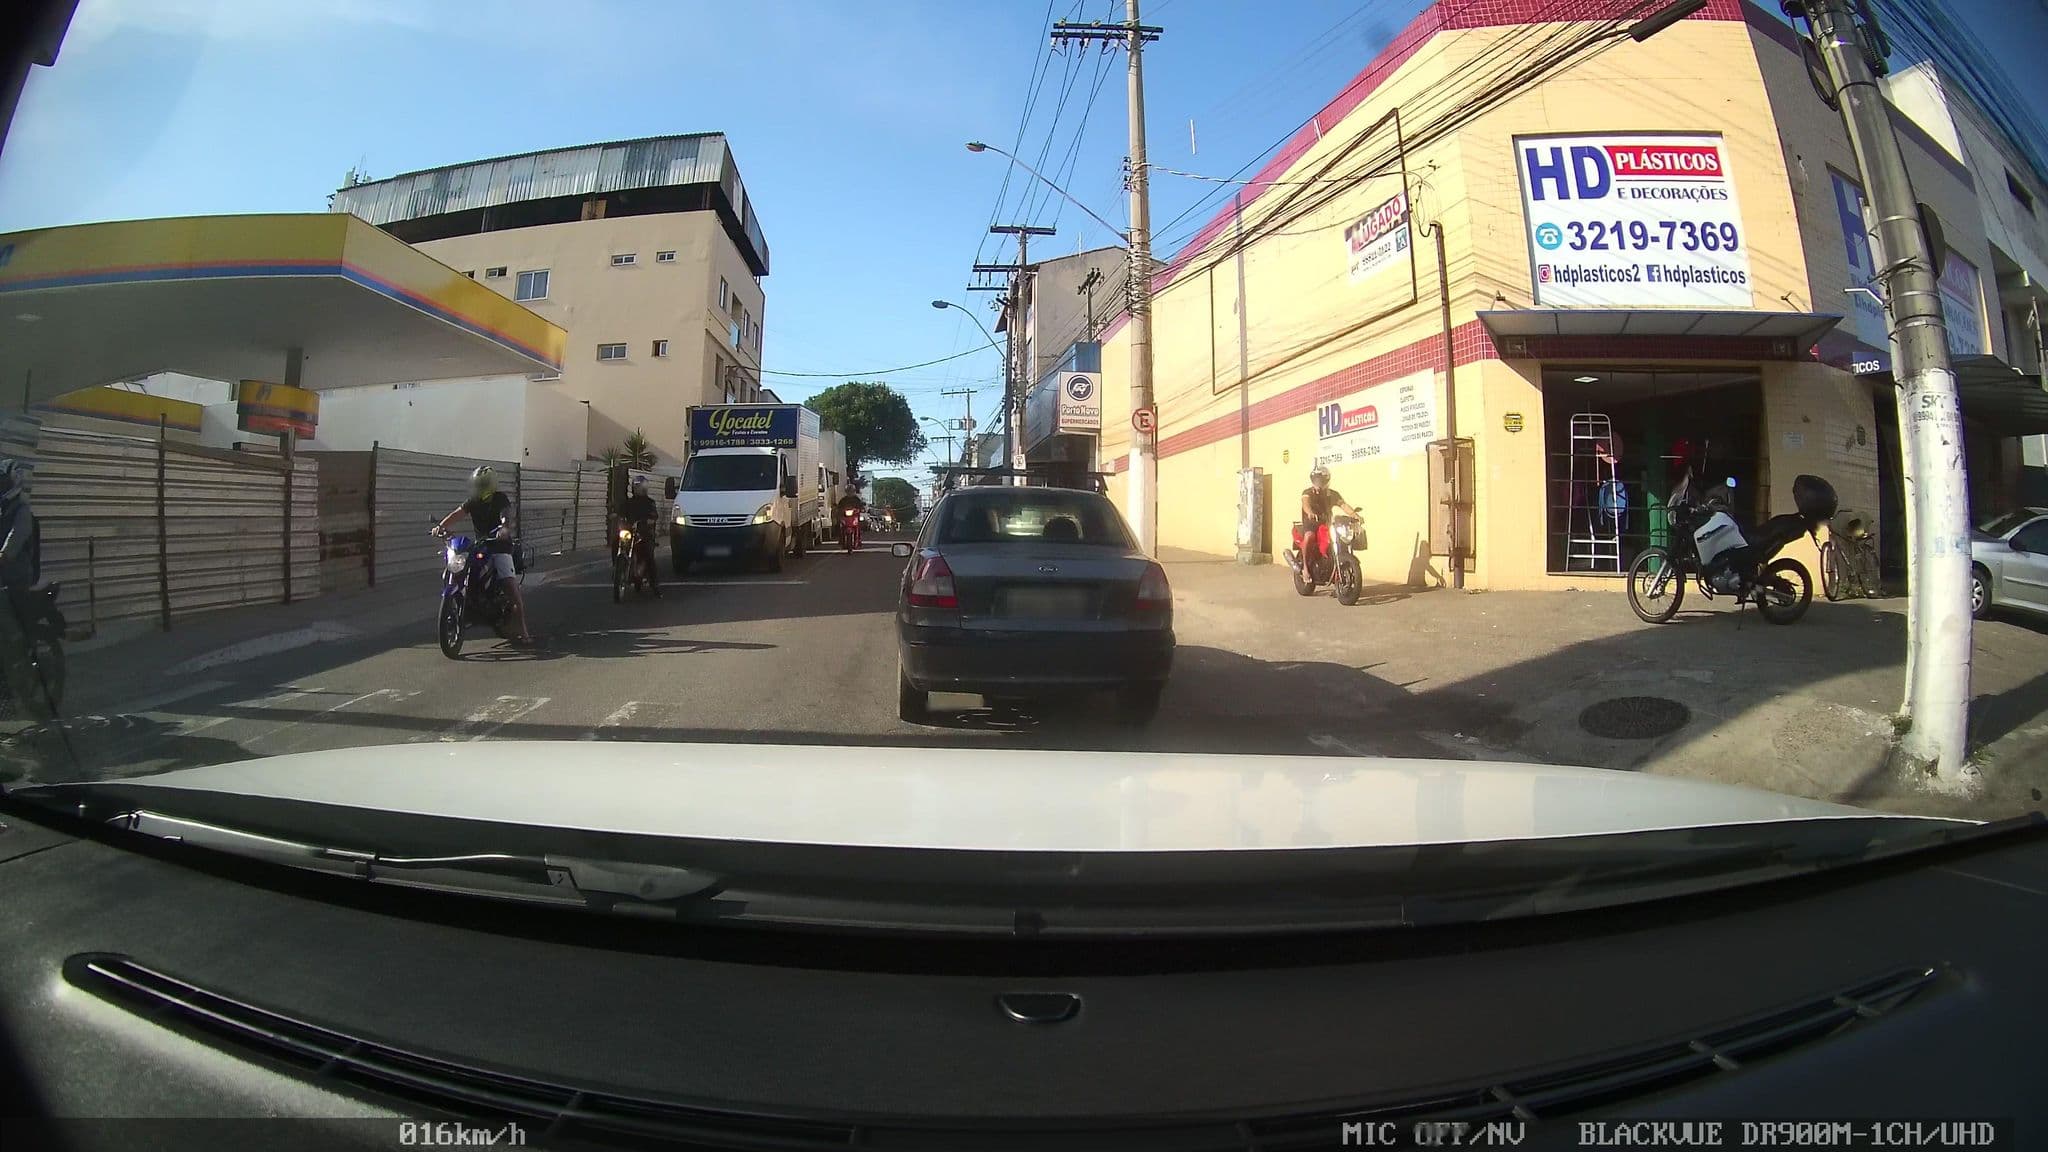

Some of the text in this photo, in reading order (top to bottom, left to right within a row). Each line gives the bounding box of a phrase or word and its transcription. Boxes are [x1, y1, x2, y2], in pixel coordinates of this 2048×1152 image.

[1525, 145, 1718, 201] HD PLÁSTICOS
[1618, 185, 1728, 203] E DECORAÇÕES
[1567, 220, 1739, 252] 3219-7369
[1554, 264, 1746, 288] hdplasticos2 hdplasticos
[709, 408, 774, 436] Locatel
[1061, 404, 1099, 417] Porto Novo
[1318, 403, 1342, 437] HD
